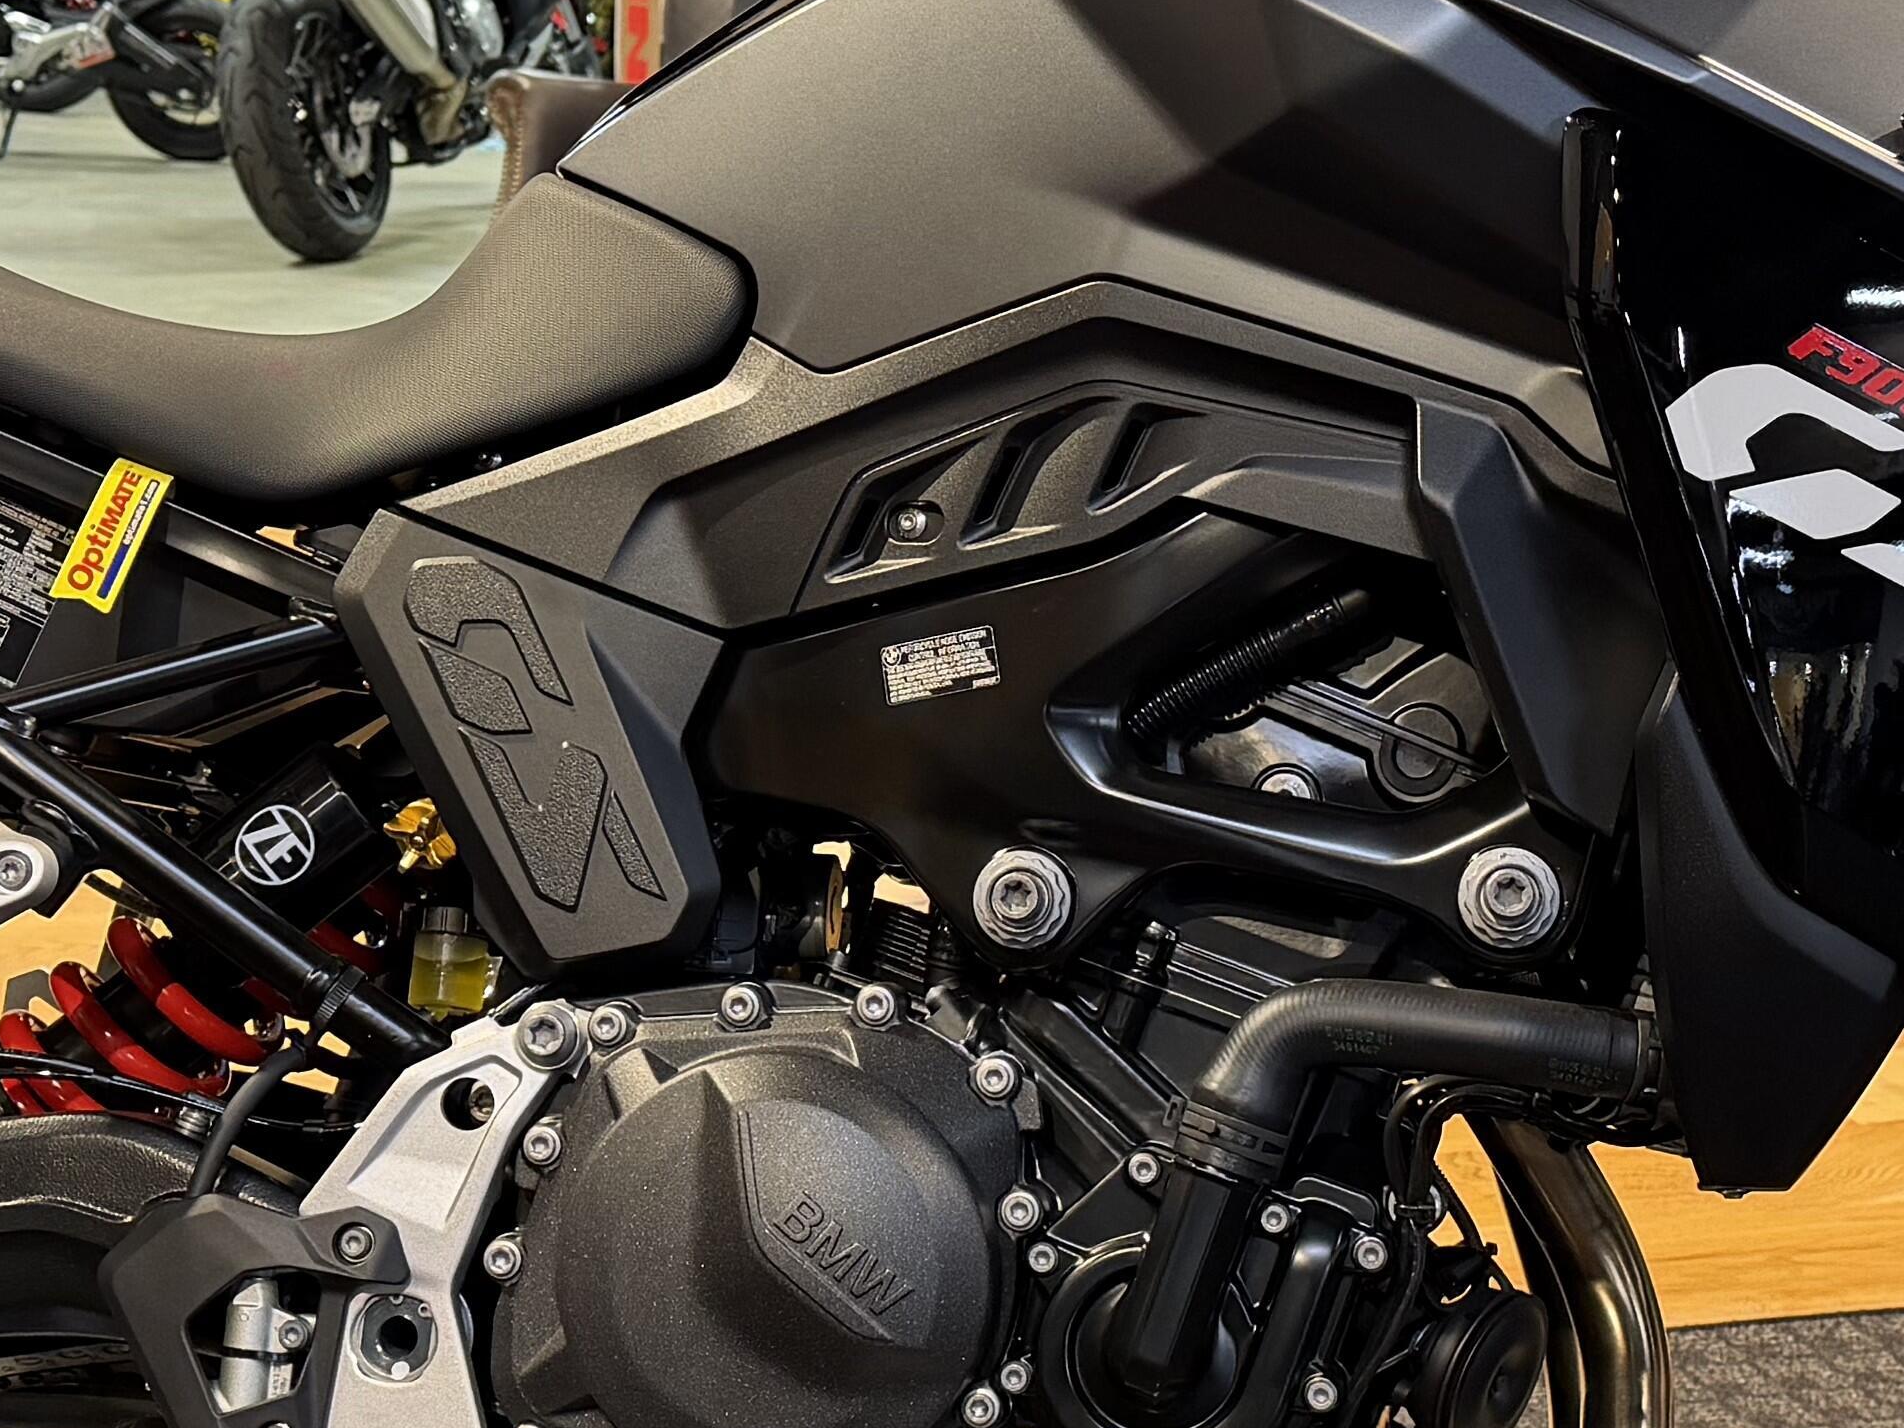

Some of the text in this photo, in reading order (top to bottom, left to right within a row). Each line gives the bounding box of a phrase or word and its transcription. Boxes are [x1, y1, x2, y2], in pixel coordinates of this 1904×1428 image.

[67, 468, 144, 591] OptiMATE
[238, 806, 313, 884] ZF
[768, 1191, 913, 1319] BMW
